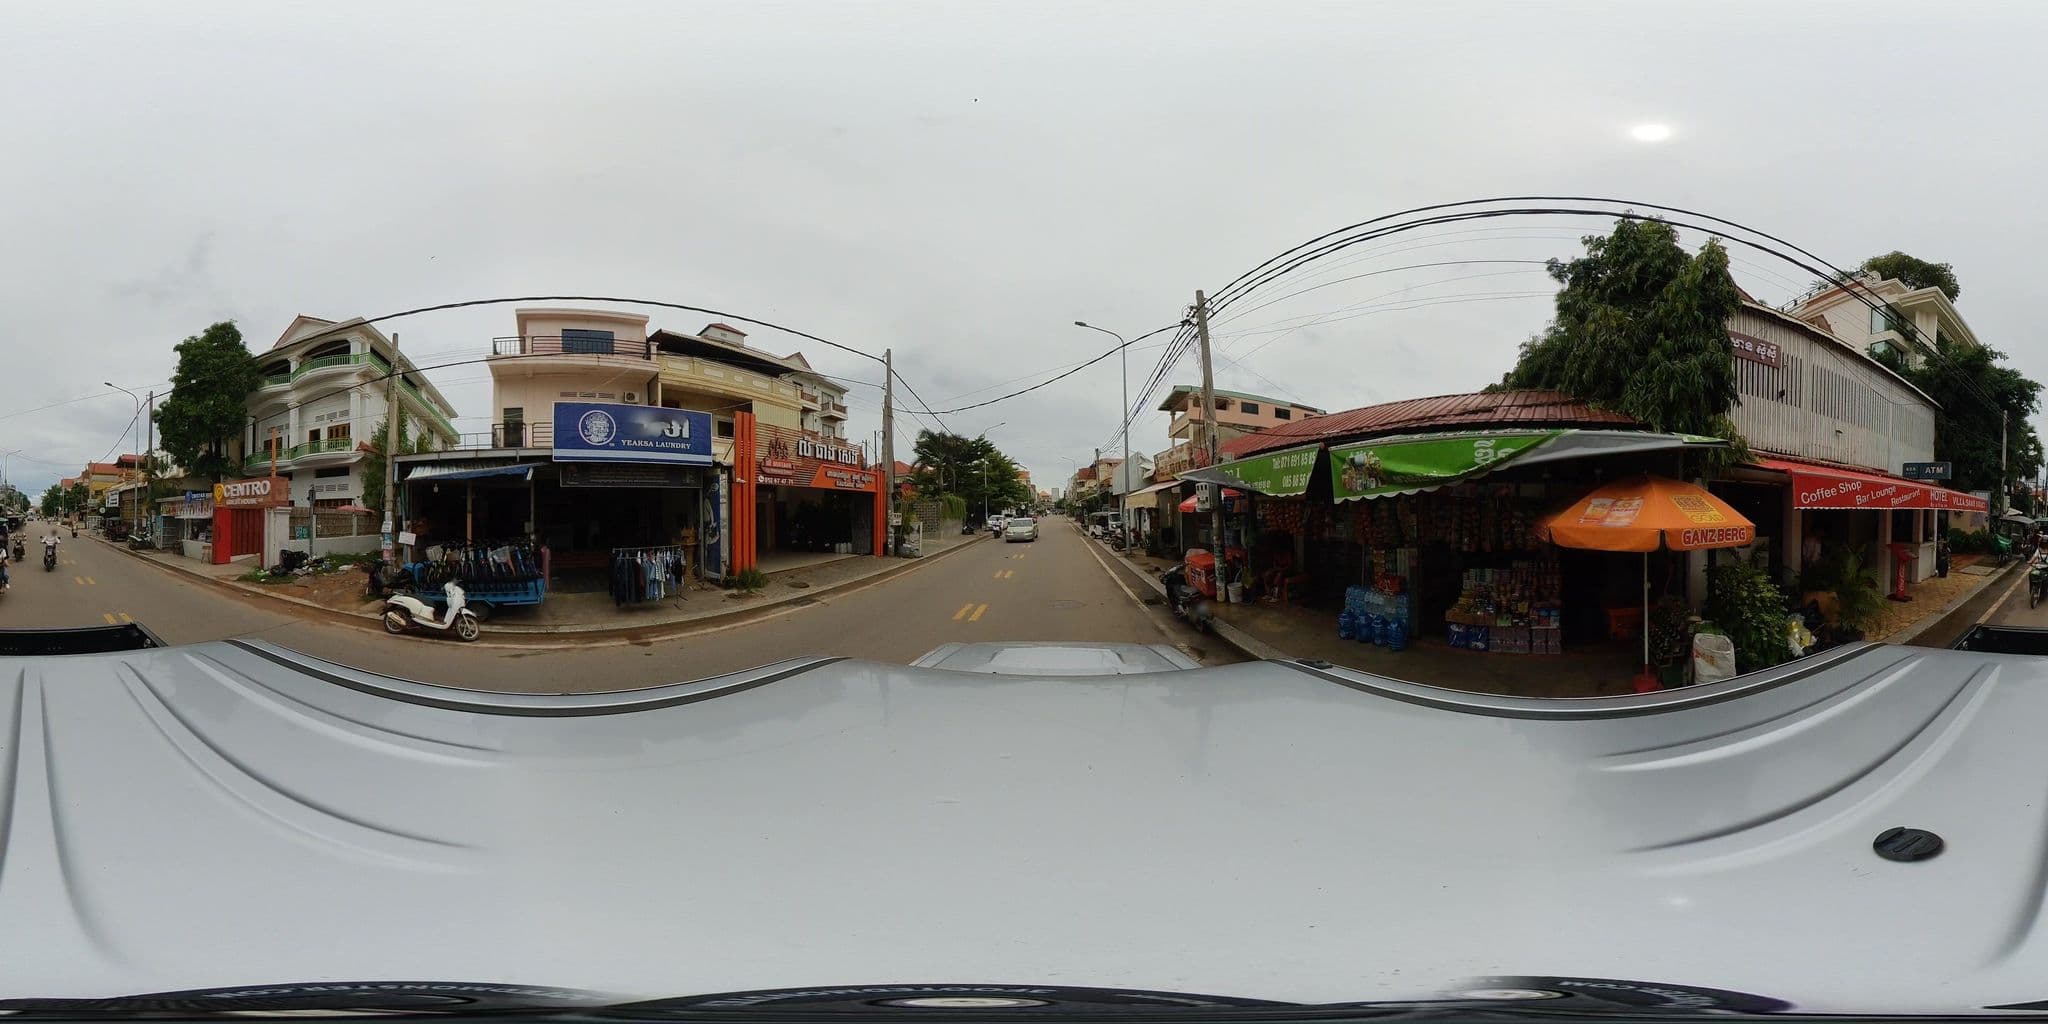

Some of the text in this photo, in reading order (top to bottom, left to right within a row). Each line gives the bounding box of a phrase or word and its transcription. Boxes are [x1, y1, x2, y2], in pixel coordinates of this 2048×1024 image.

[621, 439, 692, 450] YEAKSA LAUNDRY
[1925, 466, 1943, 474] ATM
[224, 480, 271, 498] CENTRO
[1801, 481, 1862, 504] Coffee Shop
[1855, 485, 1897, 505] Bar Lounge
[1890, 489, 1920, 507] Restaurant
[1930, 488, 1948, 502] HOTEL
[1682, 527, 1747, 546] GANZBERG
